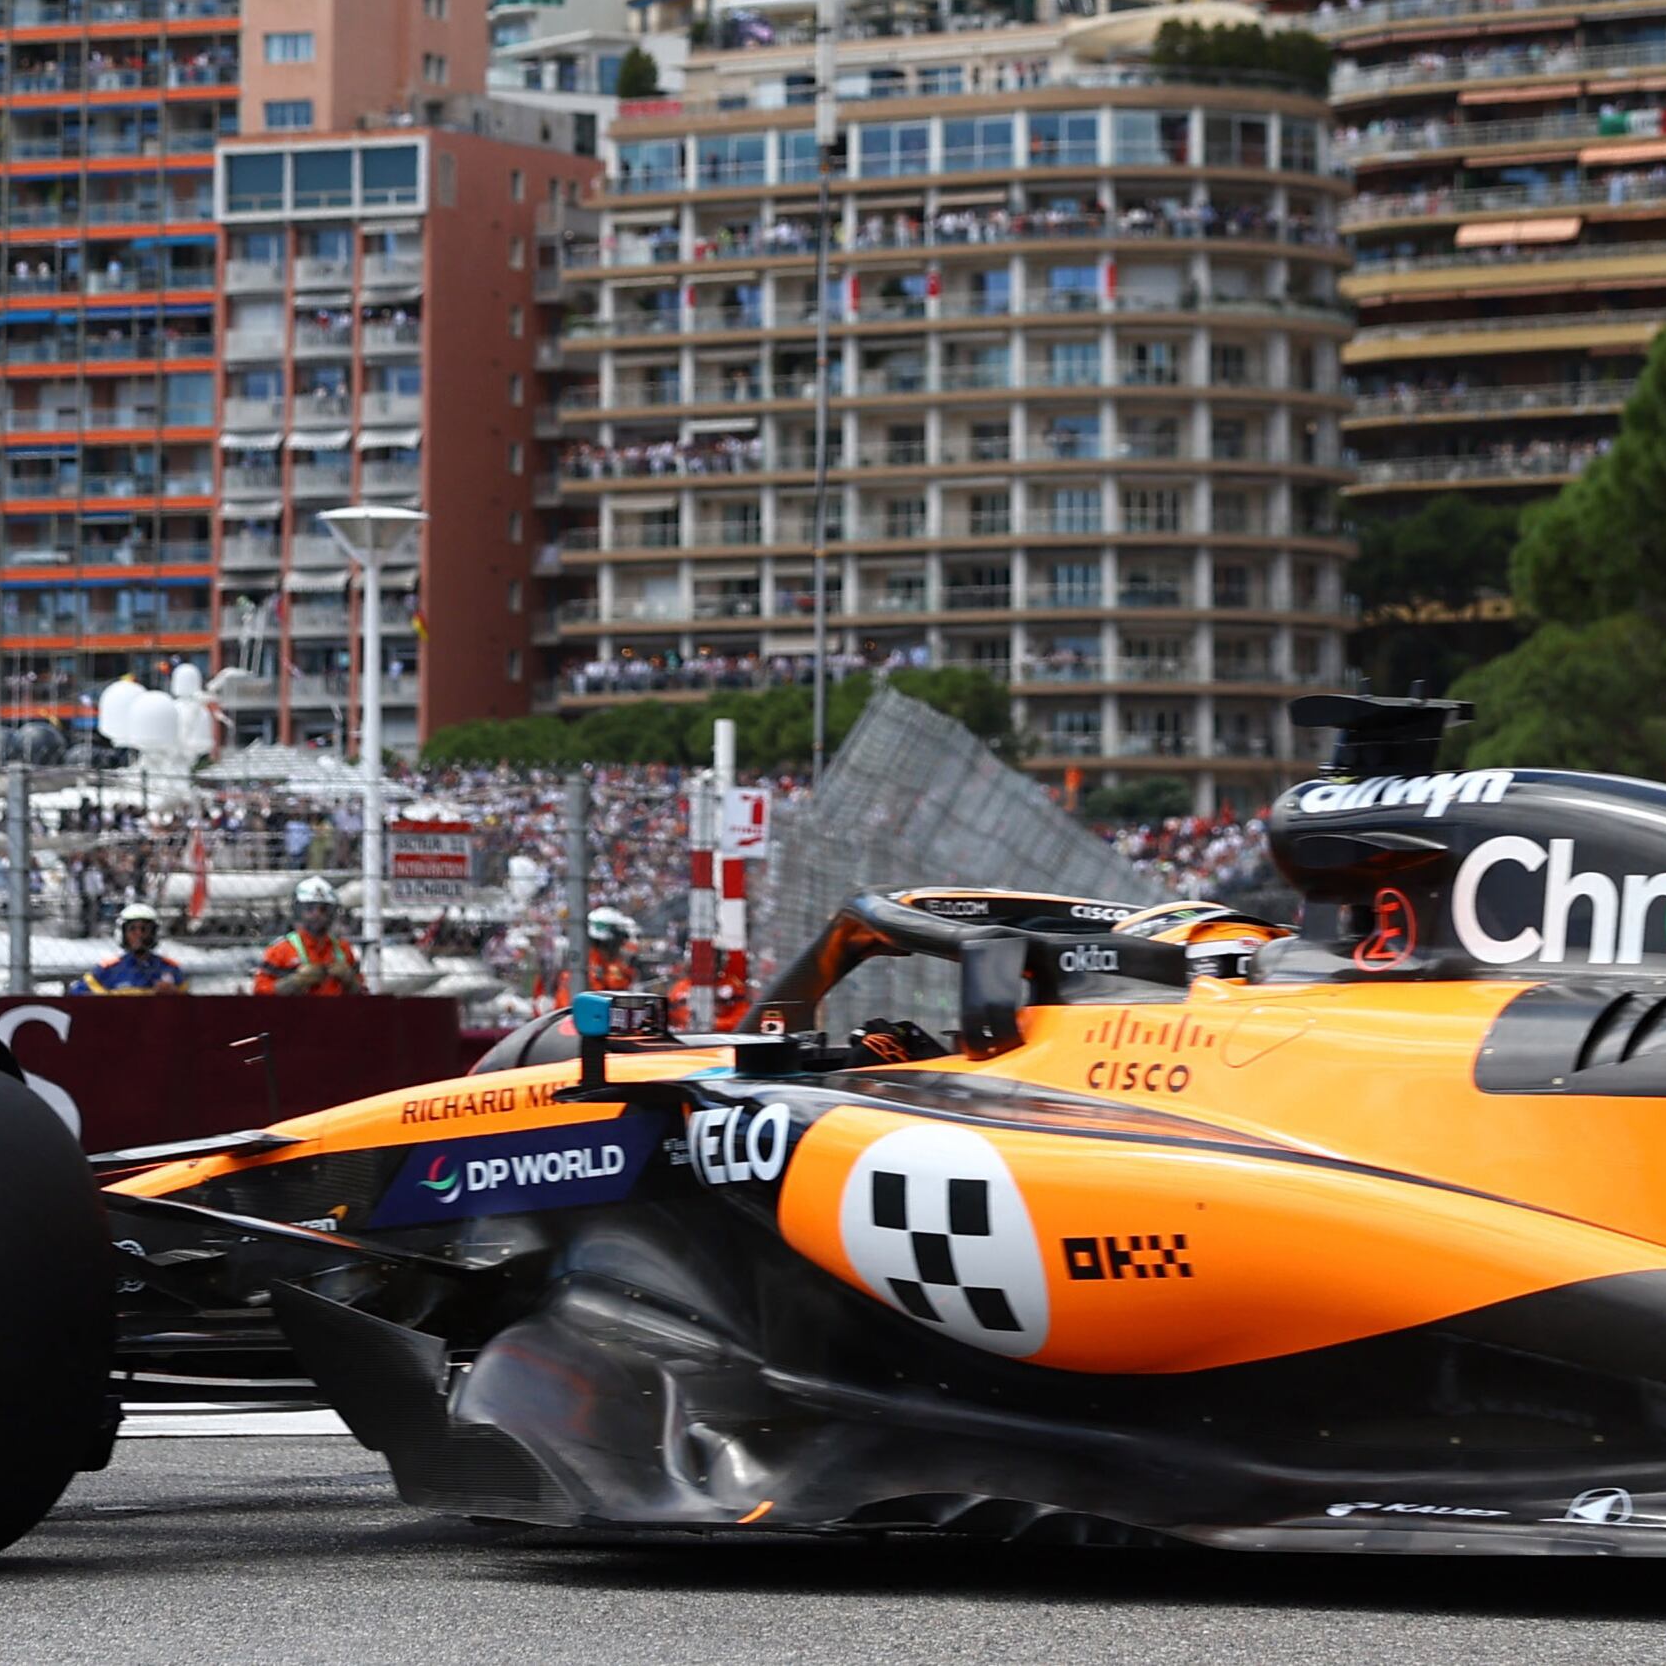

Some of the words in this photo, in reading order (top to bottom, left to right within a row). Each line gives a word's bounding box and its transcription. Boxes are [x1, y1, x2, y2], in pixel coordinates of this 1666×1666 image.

[1300, 771, 1515, 818] allwyn
[1059, 944, 1120, 972] okta
[1087, 1060, 1191, 1093] CISCO
[400, 1087, 515, 1125] RICHARD
[466, 1158, 510, 1191] DP
[510, 1144, 626, 1186] WORLD
[1062, 1234, 1194, 1281] OKX
